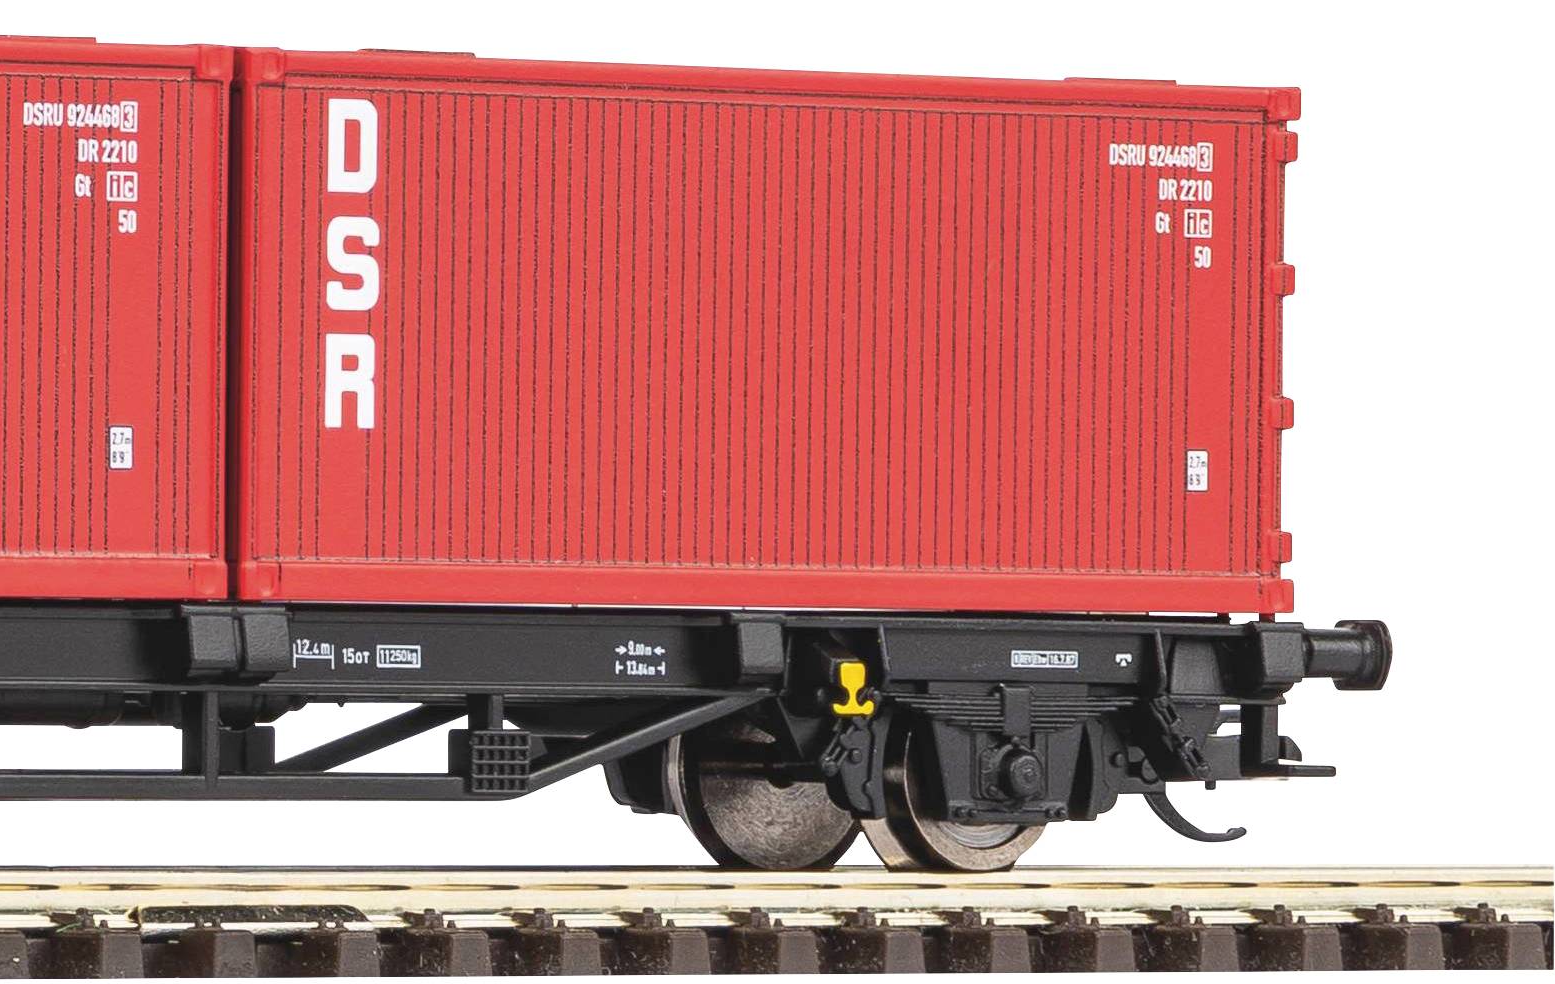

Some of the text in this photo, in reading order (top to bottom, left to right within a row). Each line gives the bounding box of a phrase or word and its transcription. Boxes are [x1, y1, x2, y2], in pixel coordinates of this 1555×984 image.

[23, 102, 63, 127] DSRU
[78, 138, 137, 163] DR 2210
[1109, 143, 1146, 166] DSRU
[75, 173, 91, 197] Gt
[1159, 178, 1212, 201] DR 2210
[118, 209, 137, 233] 50
[1155, 212, 1170, 233] Gt
[1194, 246, 1211, 268] 50
[379, 650, 417, 665] 11250kg
